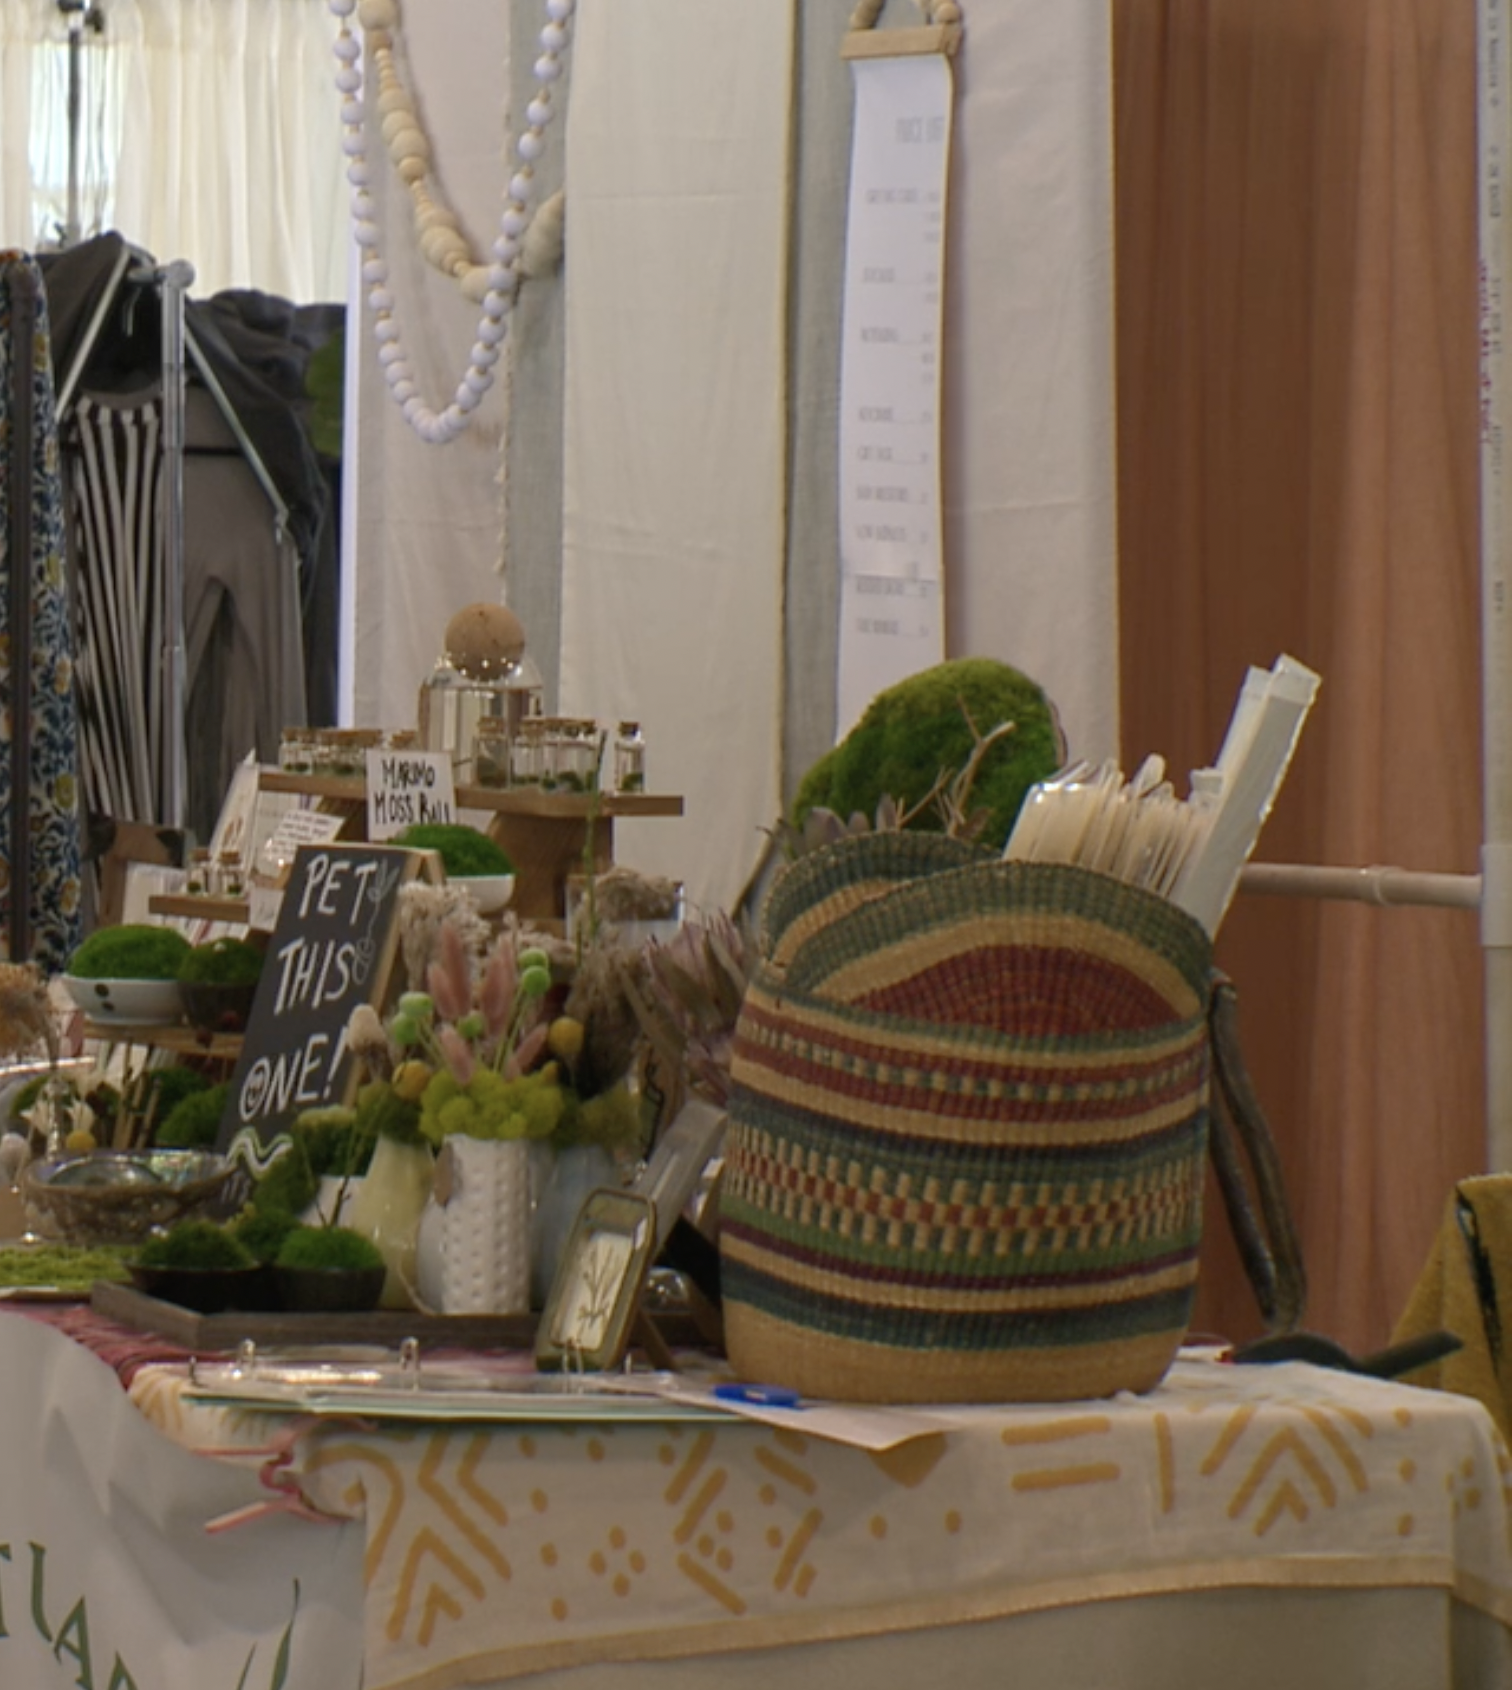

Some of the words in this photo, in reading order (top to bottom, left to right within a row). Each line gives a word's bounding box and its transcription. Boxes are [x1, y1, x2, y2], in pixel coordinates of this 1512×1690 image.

[374, 791, 413, 825] MOSS
[381, 757, 435, 789] MARIMO
[299, 854, 379, 926] PET
[273, 937, 356, 1017] THIS
[240, 1025, 349, 1122] ONE!
